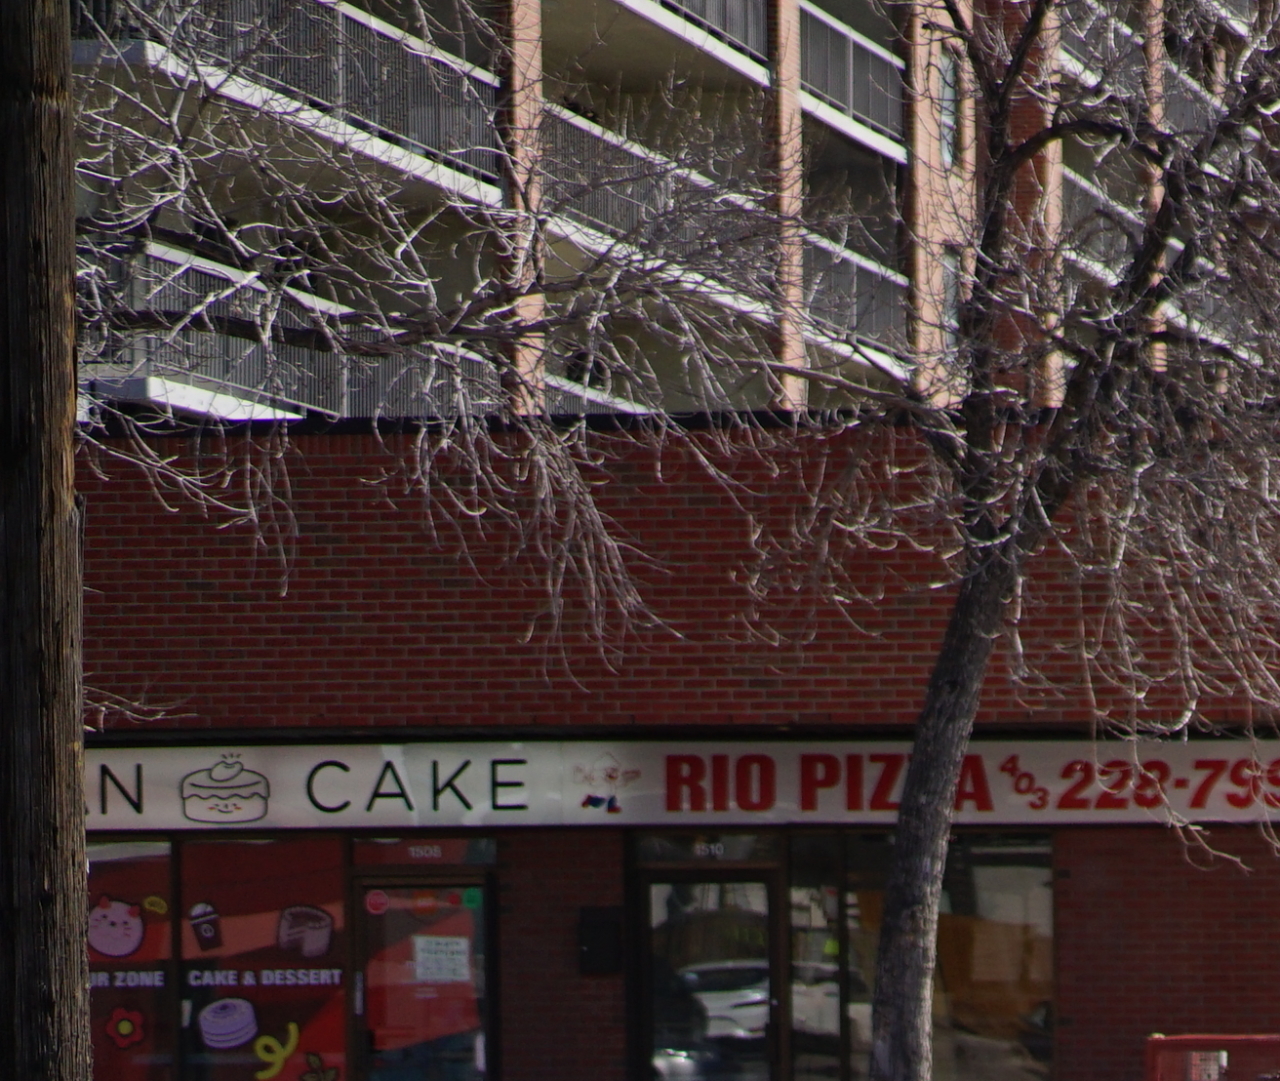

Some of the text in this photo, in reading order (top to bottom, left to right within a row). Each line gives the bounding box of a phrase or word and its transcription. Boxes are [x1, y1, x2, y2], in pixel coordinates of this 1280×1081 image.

[306, 758, 529, 814] CAKE
[664, 754, 776, 812] RIO
[800, 752, 994, 813] PIZA
[694, 842, 724, 857] 1510
[113, 970, 165, 987] ZONE
[187, 968, 343, 986] CAKE & DESSERT
